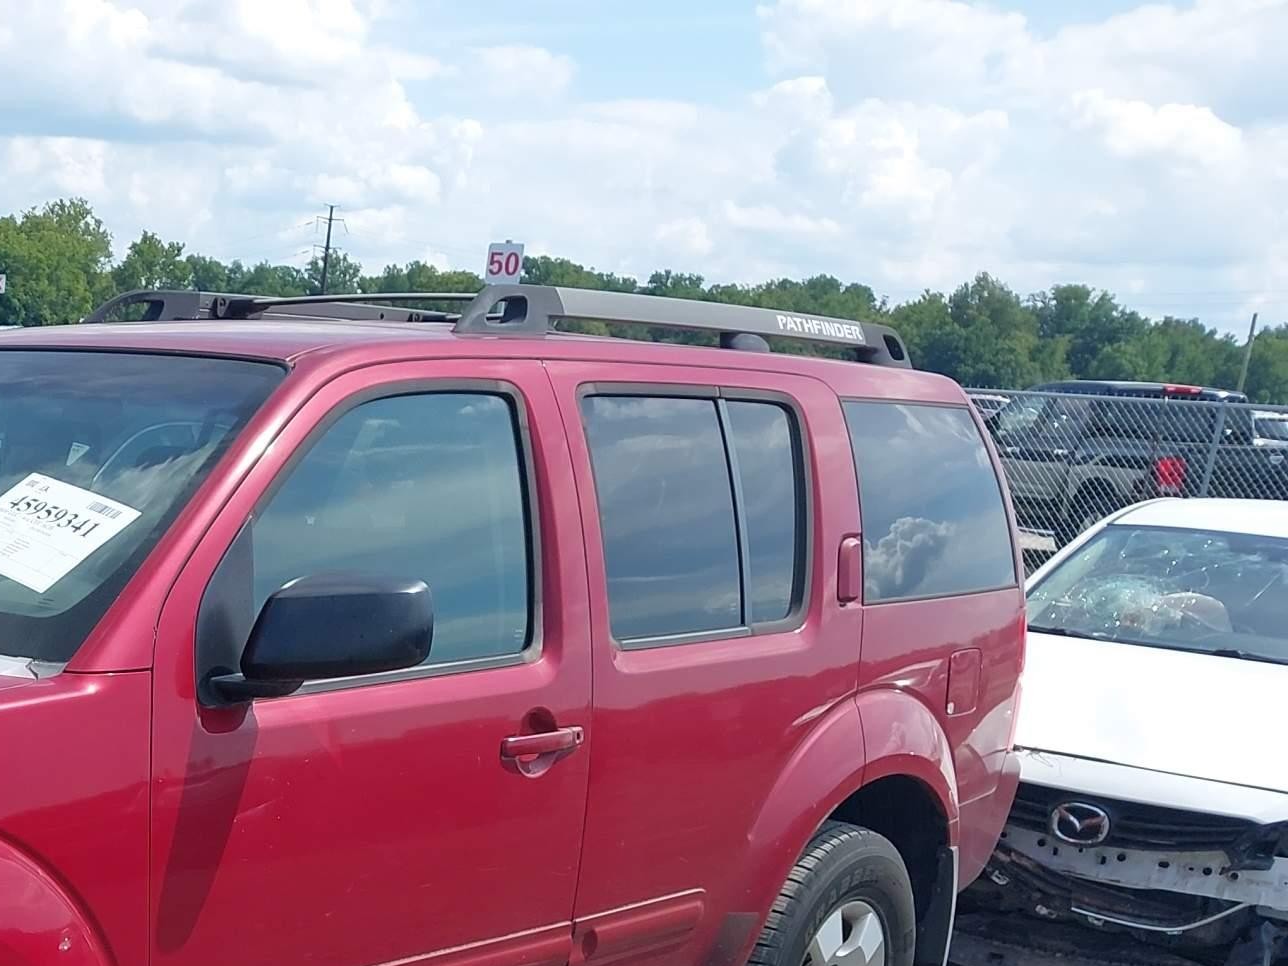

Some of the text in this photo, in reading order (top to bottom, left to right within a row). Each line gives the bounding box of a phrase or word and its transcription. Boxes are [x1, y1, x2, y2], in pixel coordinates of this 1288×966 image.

[488, 251, 520, 276] 50
[775, 314, 864, 340] PATHFINDER
[9, 495, 101, 537] 45959341
